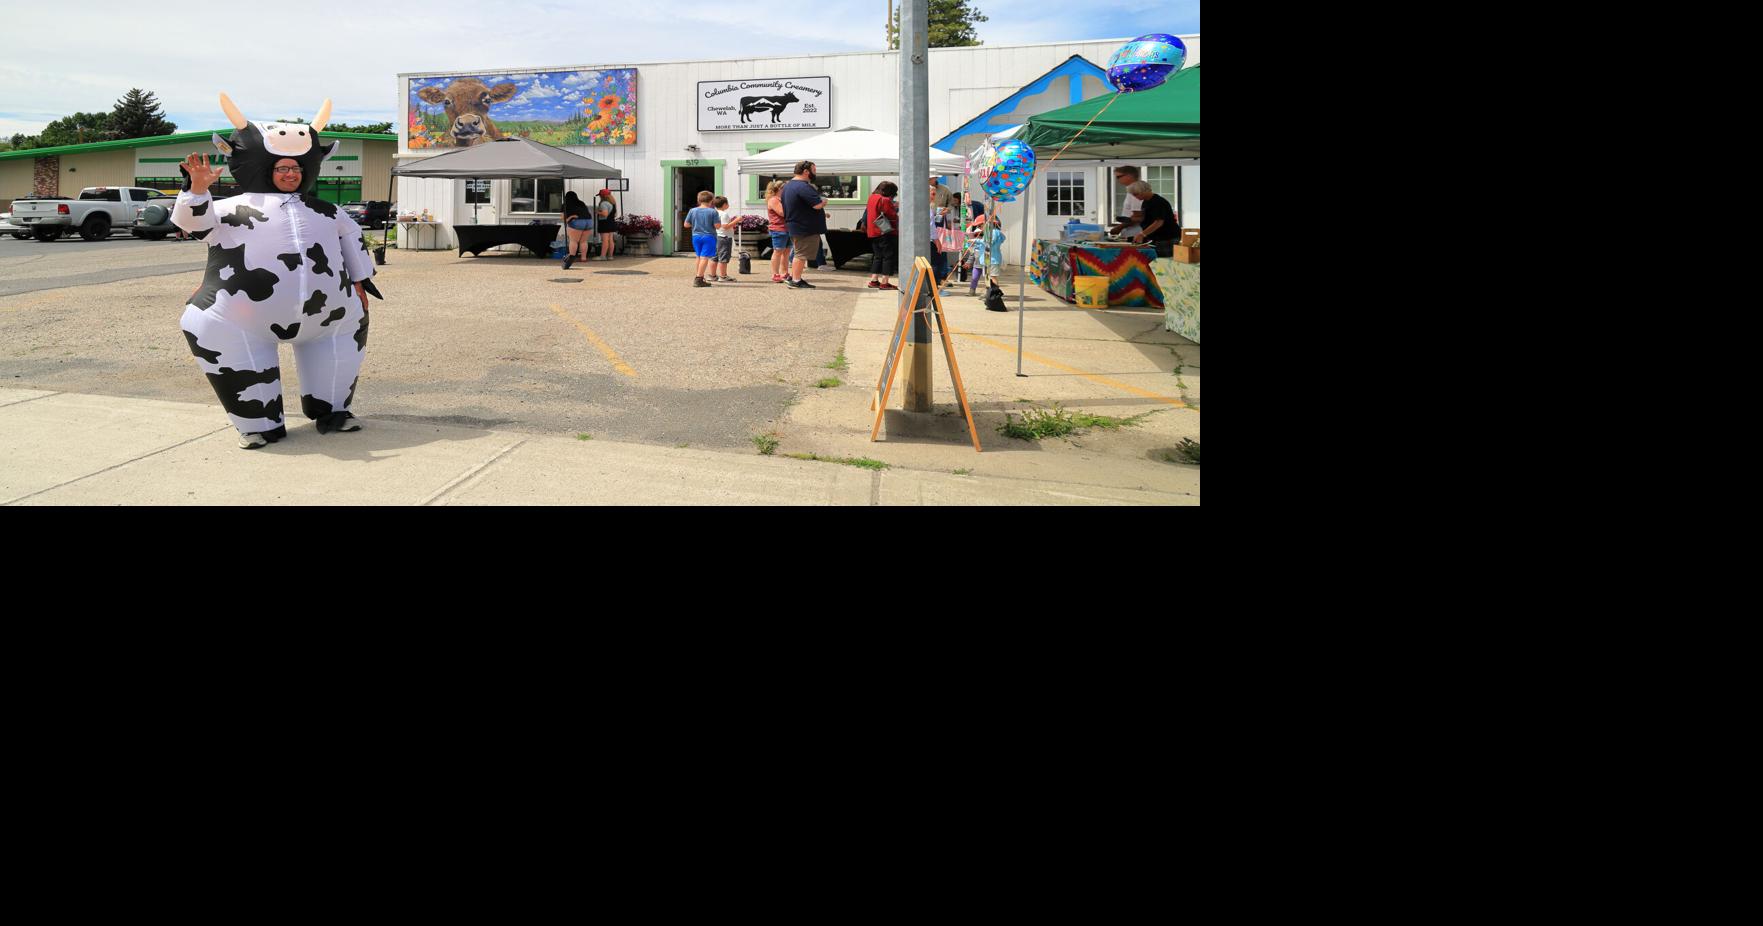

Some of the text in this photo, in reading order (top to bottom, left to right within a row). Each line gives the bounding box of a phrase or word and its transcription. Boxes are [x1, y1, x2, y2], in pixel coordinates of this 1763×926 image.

[705, 81, 822, 98] Columbia Community Creamery
